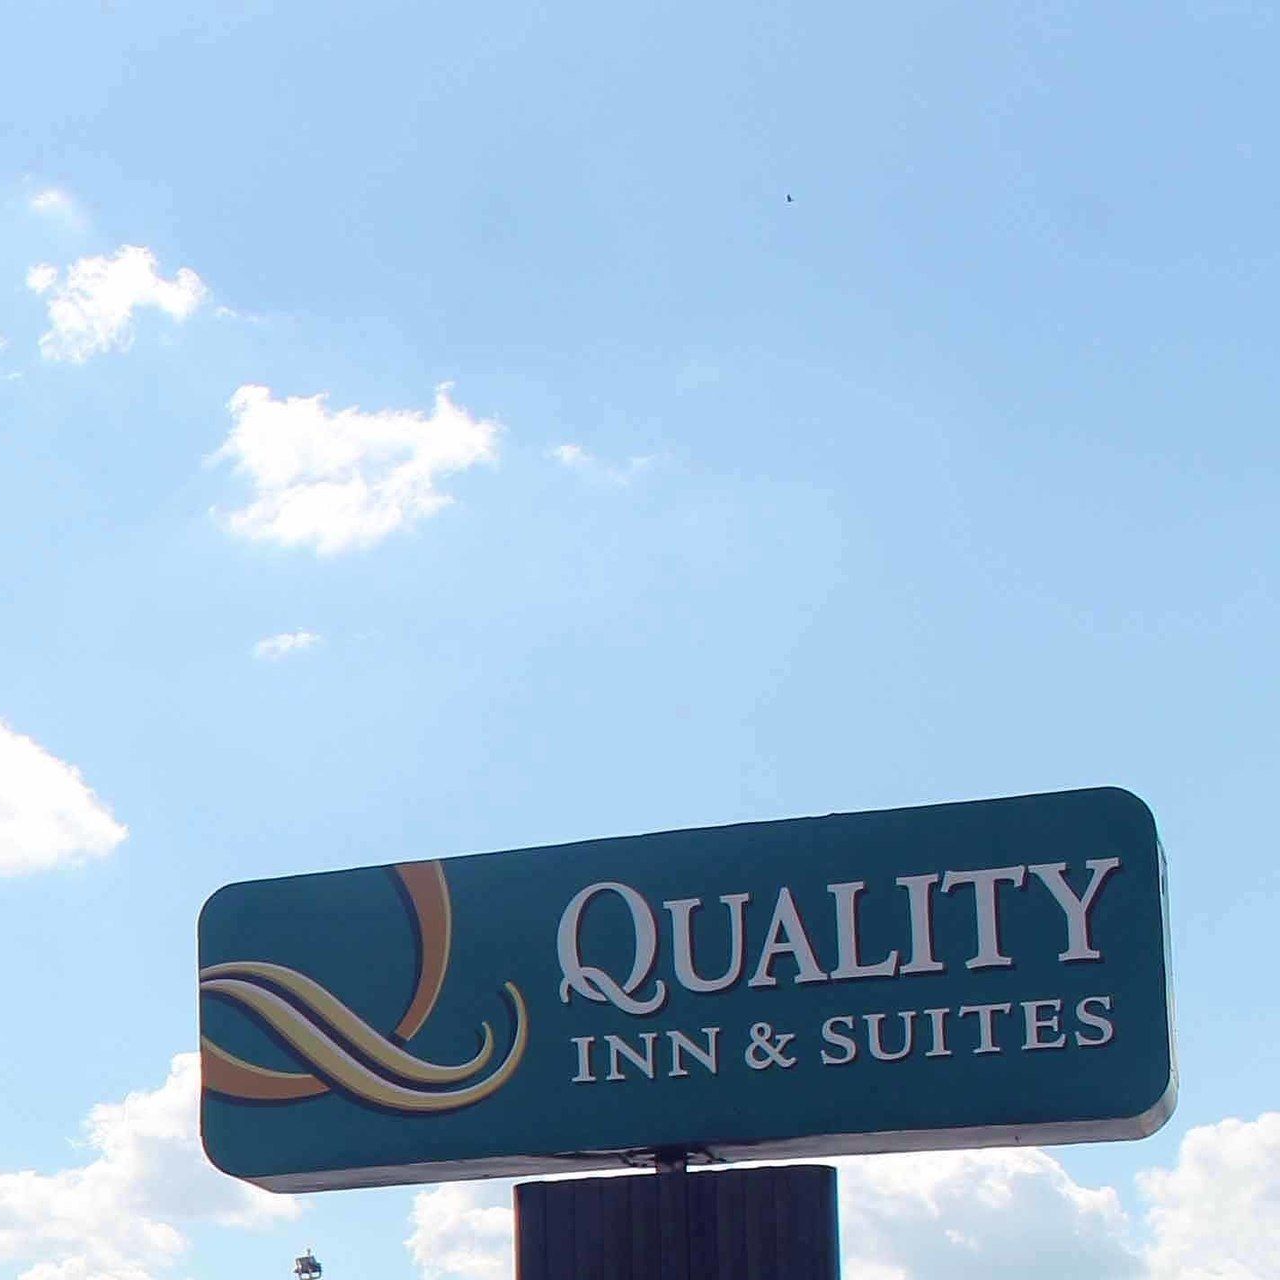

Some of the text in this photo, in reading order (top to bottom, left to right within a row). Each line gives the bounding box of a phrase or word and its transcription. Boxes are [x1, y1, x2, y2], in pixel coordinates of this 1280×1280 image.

[556, 856, 1121, 1015] QUALITY
[569, 995, 1115, 1083] INN & SUITES
